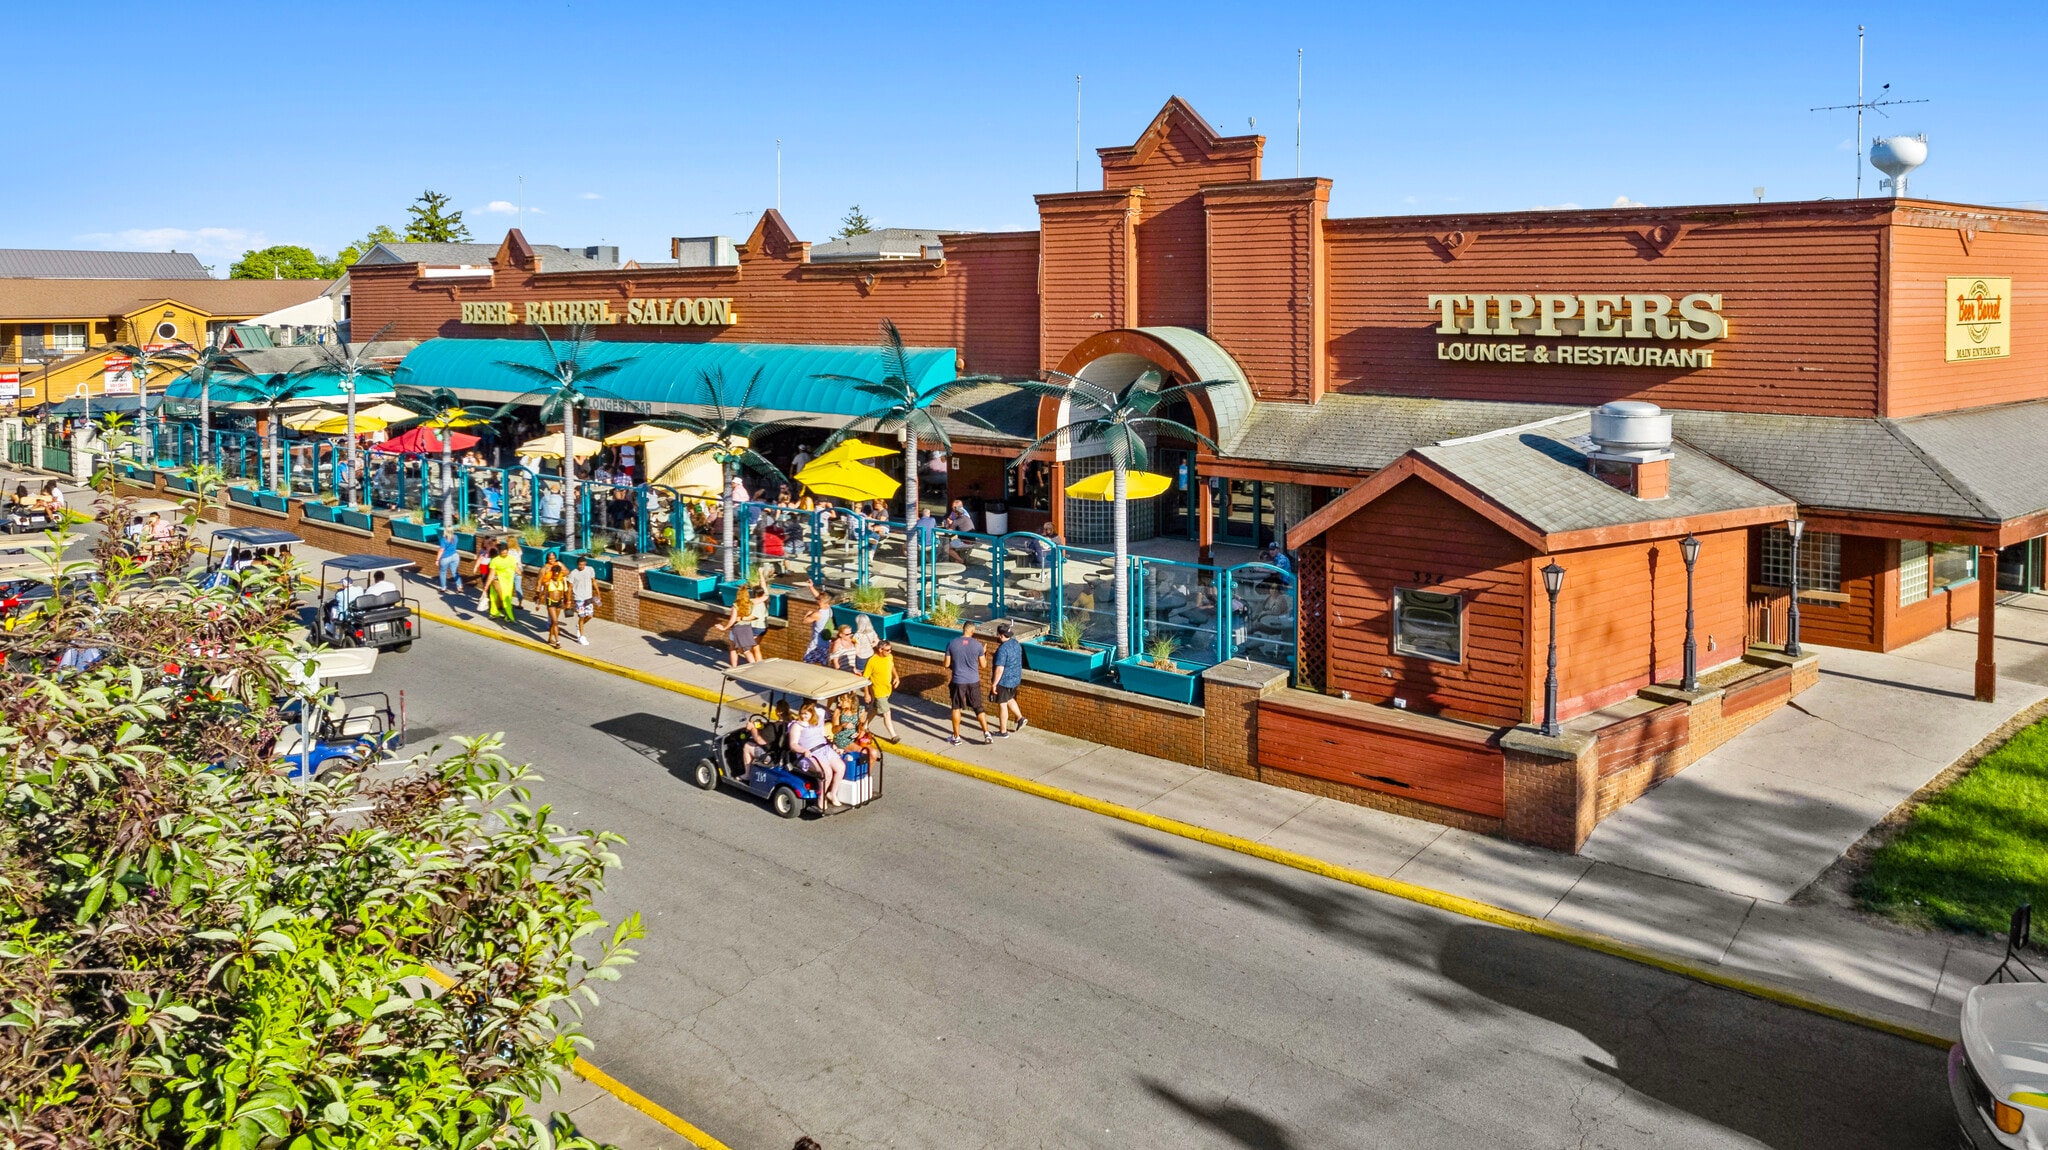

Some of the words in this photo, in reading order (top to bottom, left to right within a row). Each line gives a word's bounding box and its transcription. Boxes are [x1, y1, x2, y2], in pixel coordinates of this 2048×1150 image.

[460, 301, 515, 325] BEER
[524, 300, 614, 326] BARREL
[627, 297, 735, 326] SALOON
[1428, 293, 1724, 341] TIPPERS
[1437, 342, 1527, 363] LOUNGE
[1533, 344, 1551, 364] &
[1557, 345, 1715, 369] RESTAURANT
[1956, 348, 1972, 358] MAIN
[1972, 345, 2001, 357] ENTRANCE
[588, 398, 630, 413] LONGEST
[633, 401, 652, 416] BAR
